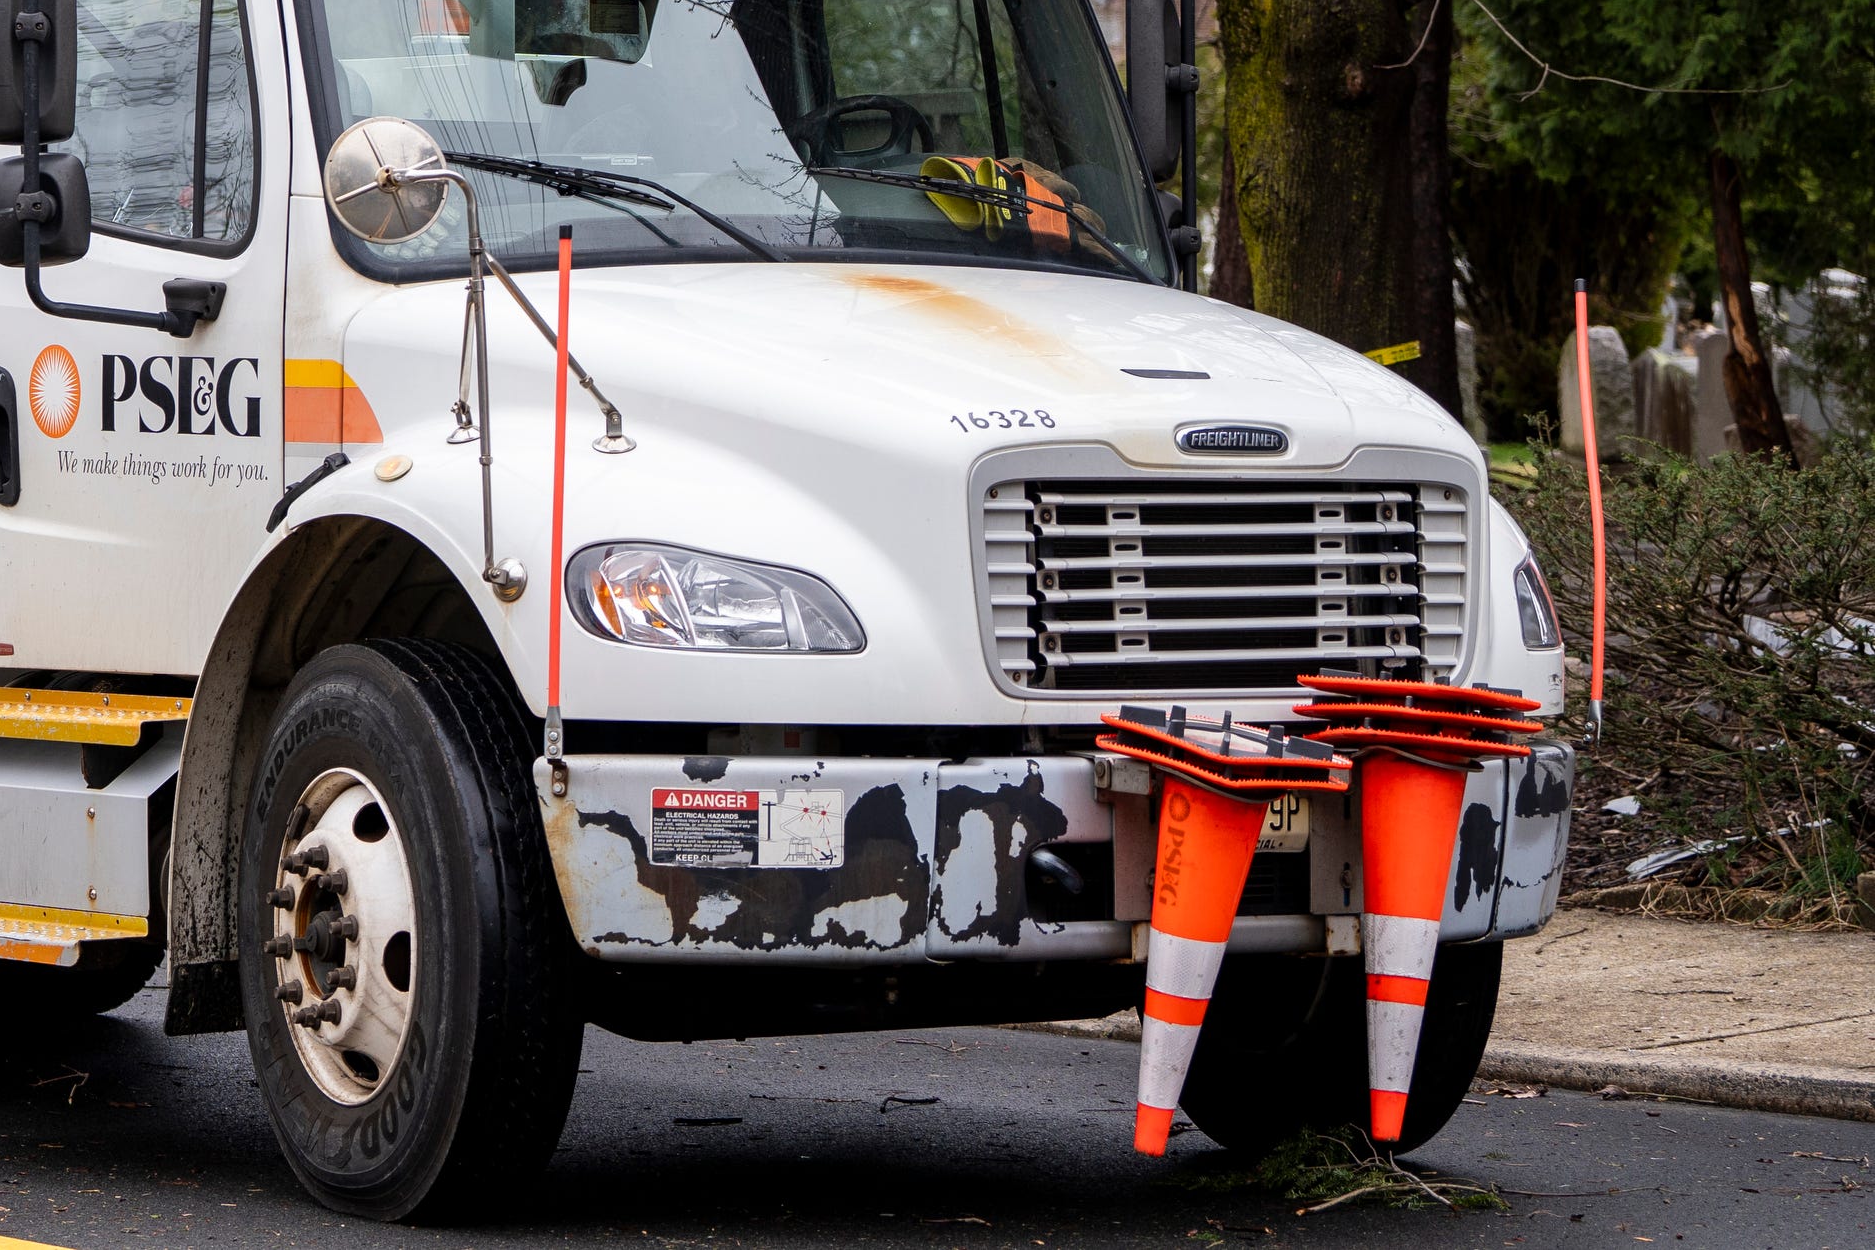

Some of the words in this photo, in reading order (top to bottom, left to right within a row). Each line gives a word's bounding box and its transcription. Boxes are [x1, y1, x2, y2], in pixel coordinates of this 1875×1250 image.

[950, 408, 1056, 433] 16328
[1190, 430, 1280, 448] FREIGHTLINER
[57, 450, 78, 474] We
[82, 452, 119, 476] make
[122, 452, 167, 485] things
[172, 455, 207, 479] work
[209, 455, 234, 487] for
[236, 463, 269, 488] you.
[257, 708, 362, 823] ENDURANCE
[682, 793, 747, 808] DANGER
[258, 1020, 427, 1170] GOODYEAR
